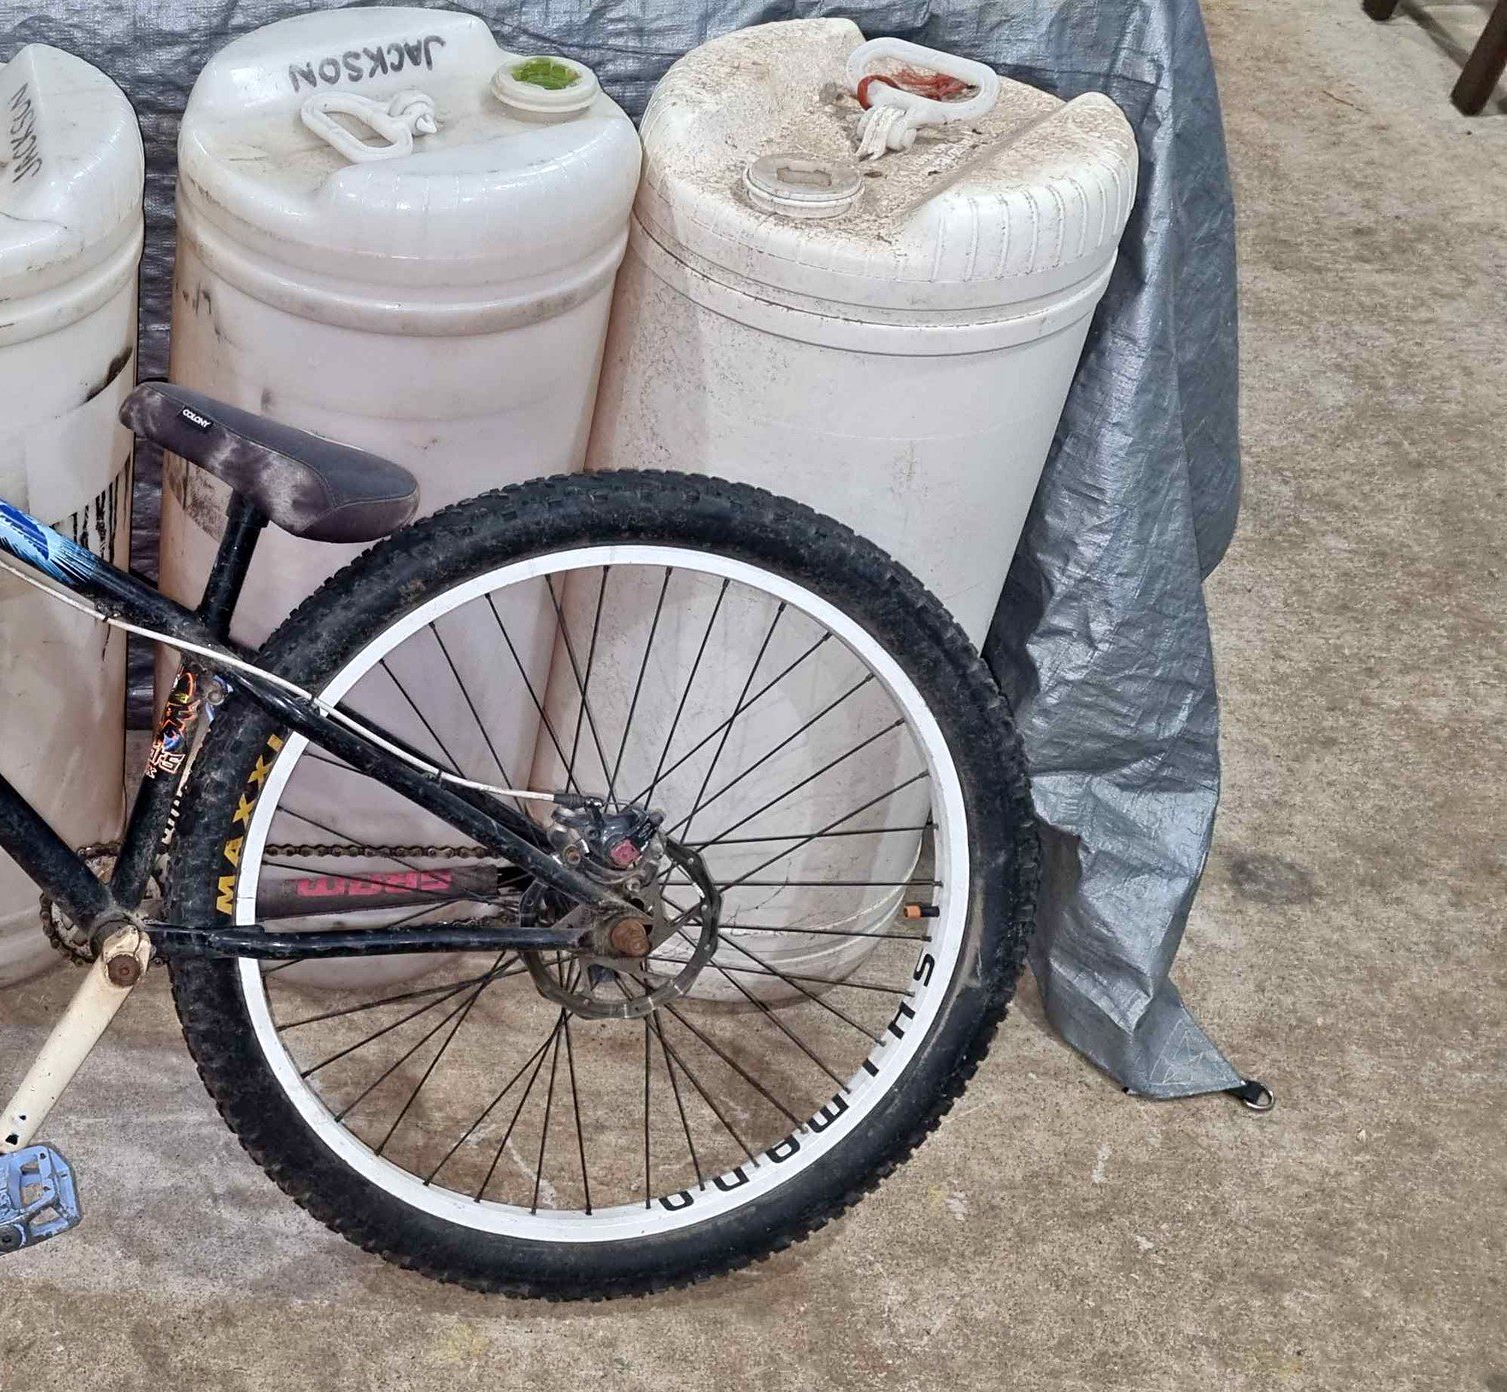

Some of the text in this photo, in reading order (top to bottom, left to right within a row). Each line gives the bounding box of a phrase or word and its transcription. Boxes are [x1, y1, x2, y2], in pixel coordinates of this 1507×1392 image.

[288, 33, 446, 92] JACKSON
[181, 407, 212, 428] COLONY
[216, 735, 284, 915] MAXXI
